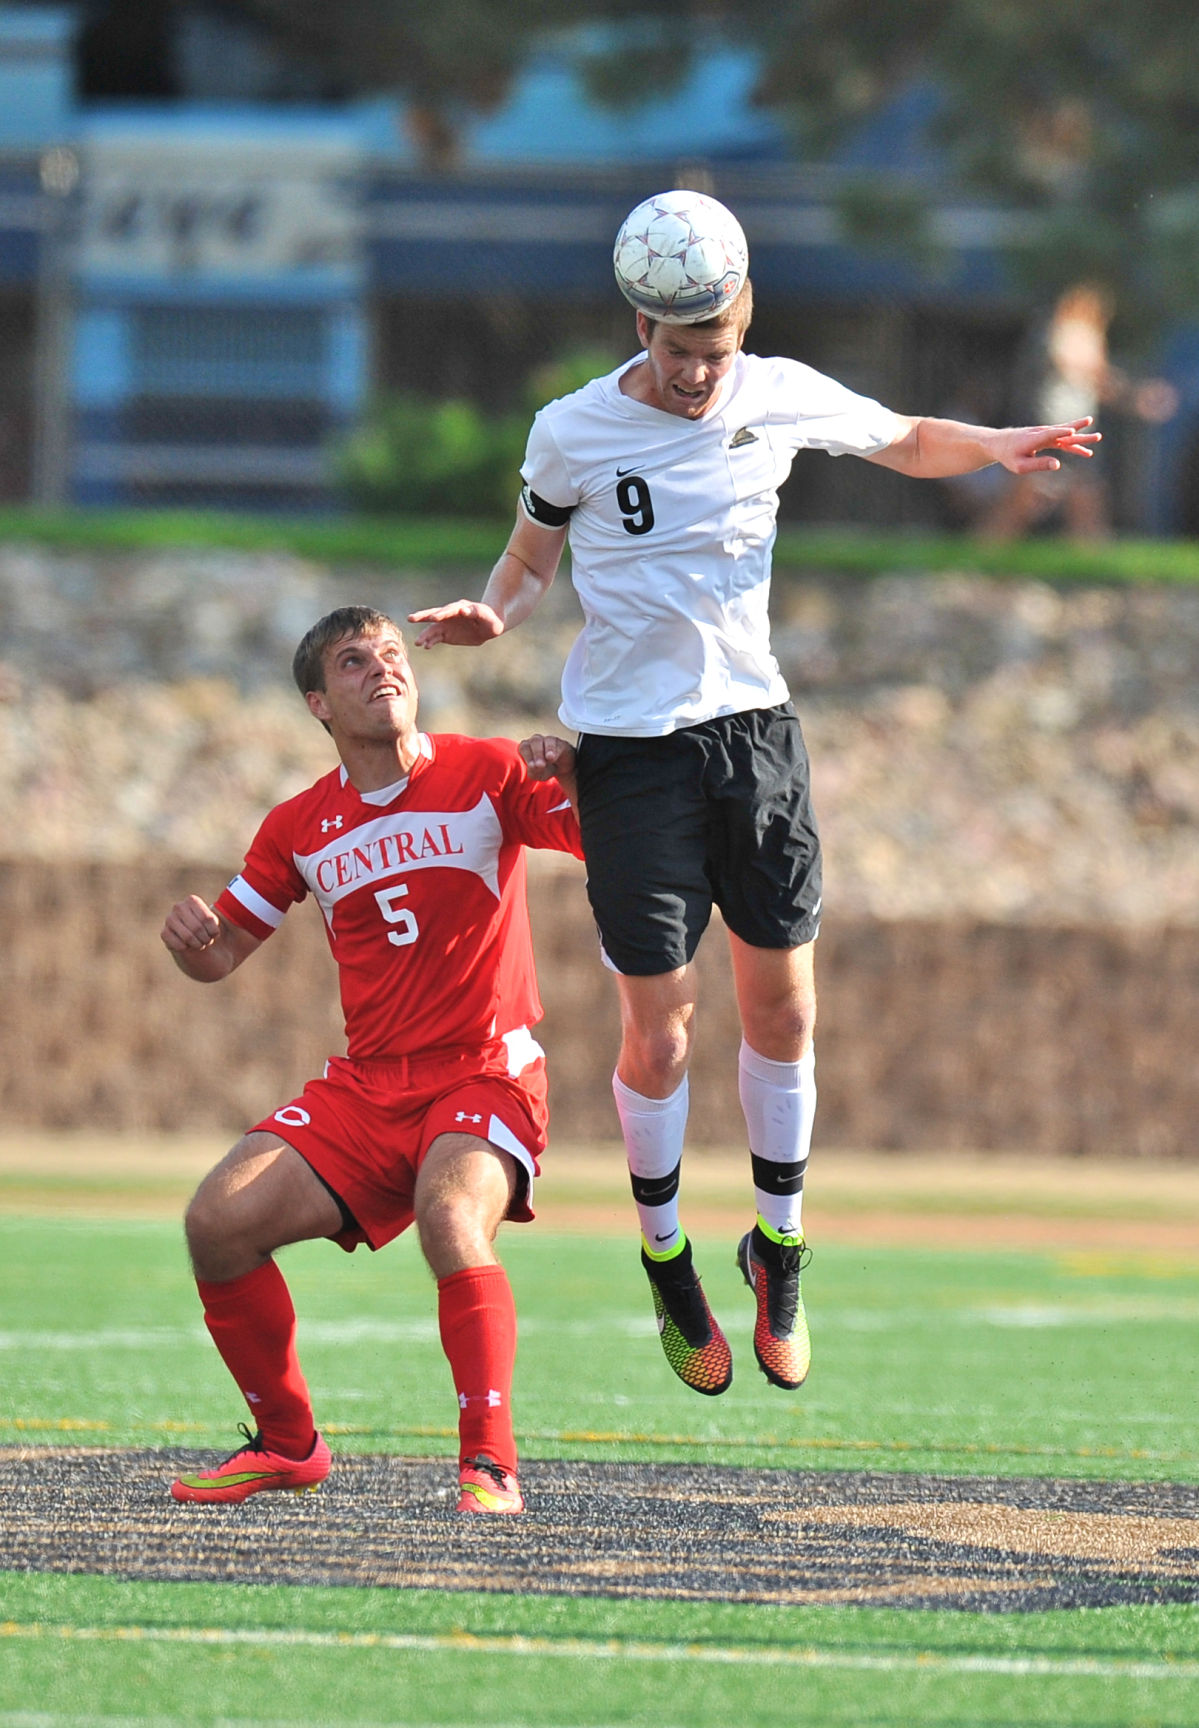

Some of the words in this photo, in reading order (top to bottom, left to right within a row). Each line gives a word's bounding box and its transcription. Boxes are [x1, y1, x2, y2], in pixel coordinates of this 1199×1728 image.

[616, 476, 655, 535] 9
[316, 824, 464, 894] CENTRAL
[374, 884, 419, 946] 5
